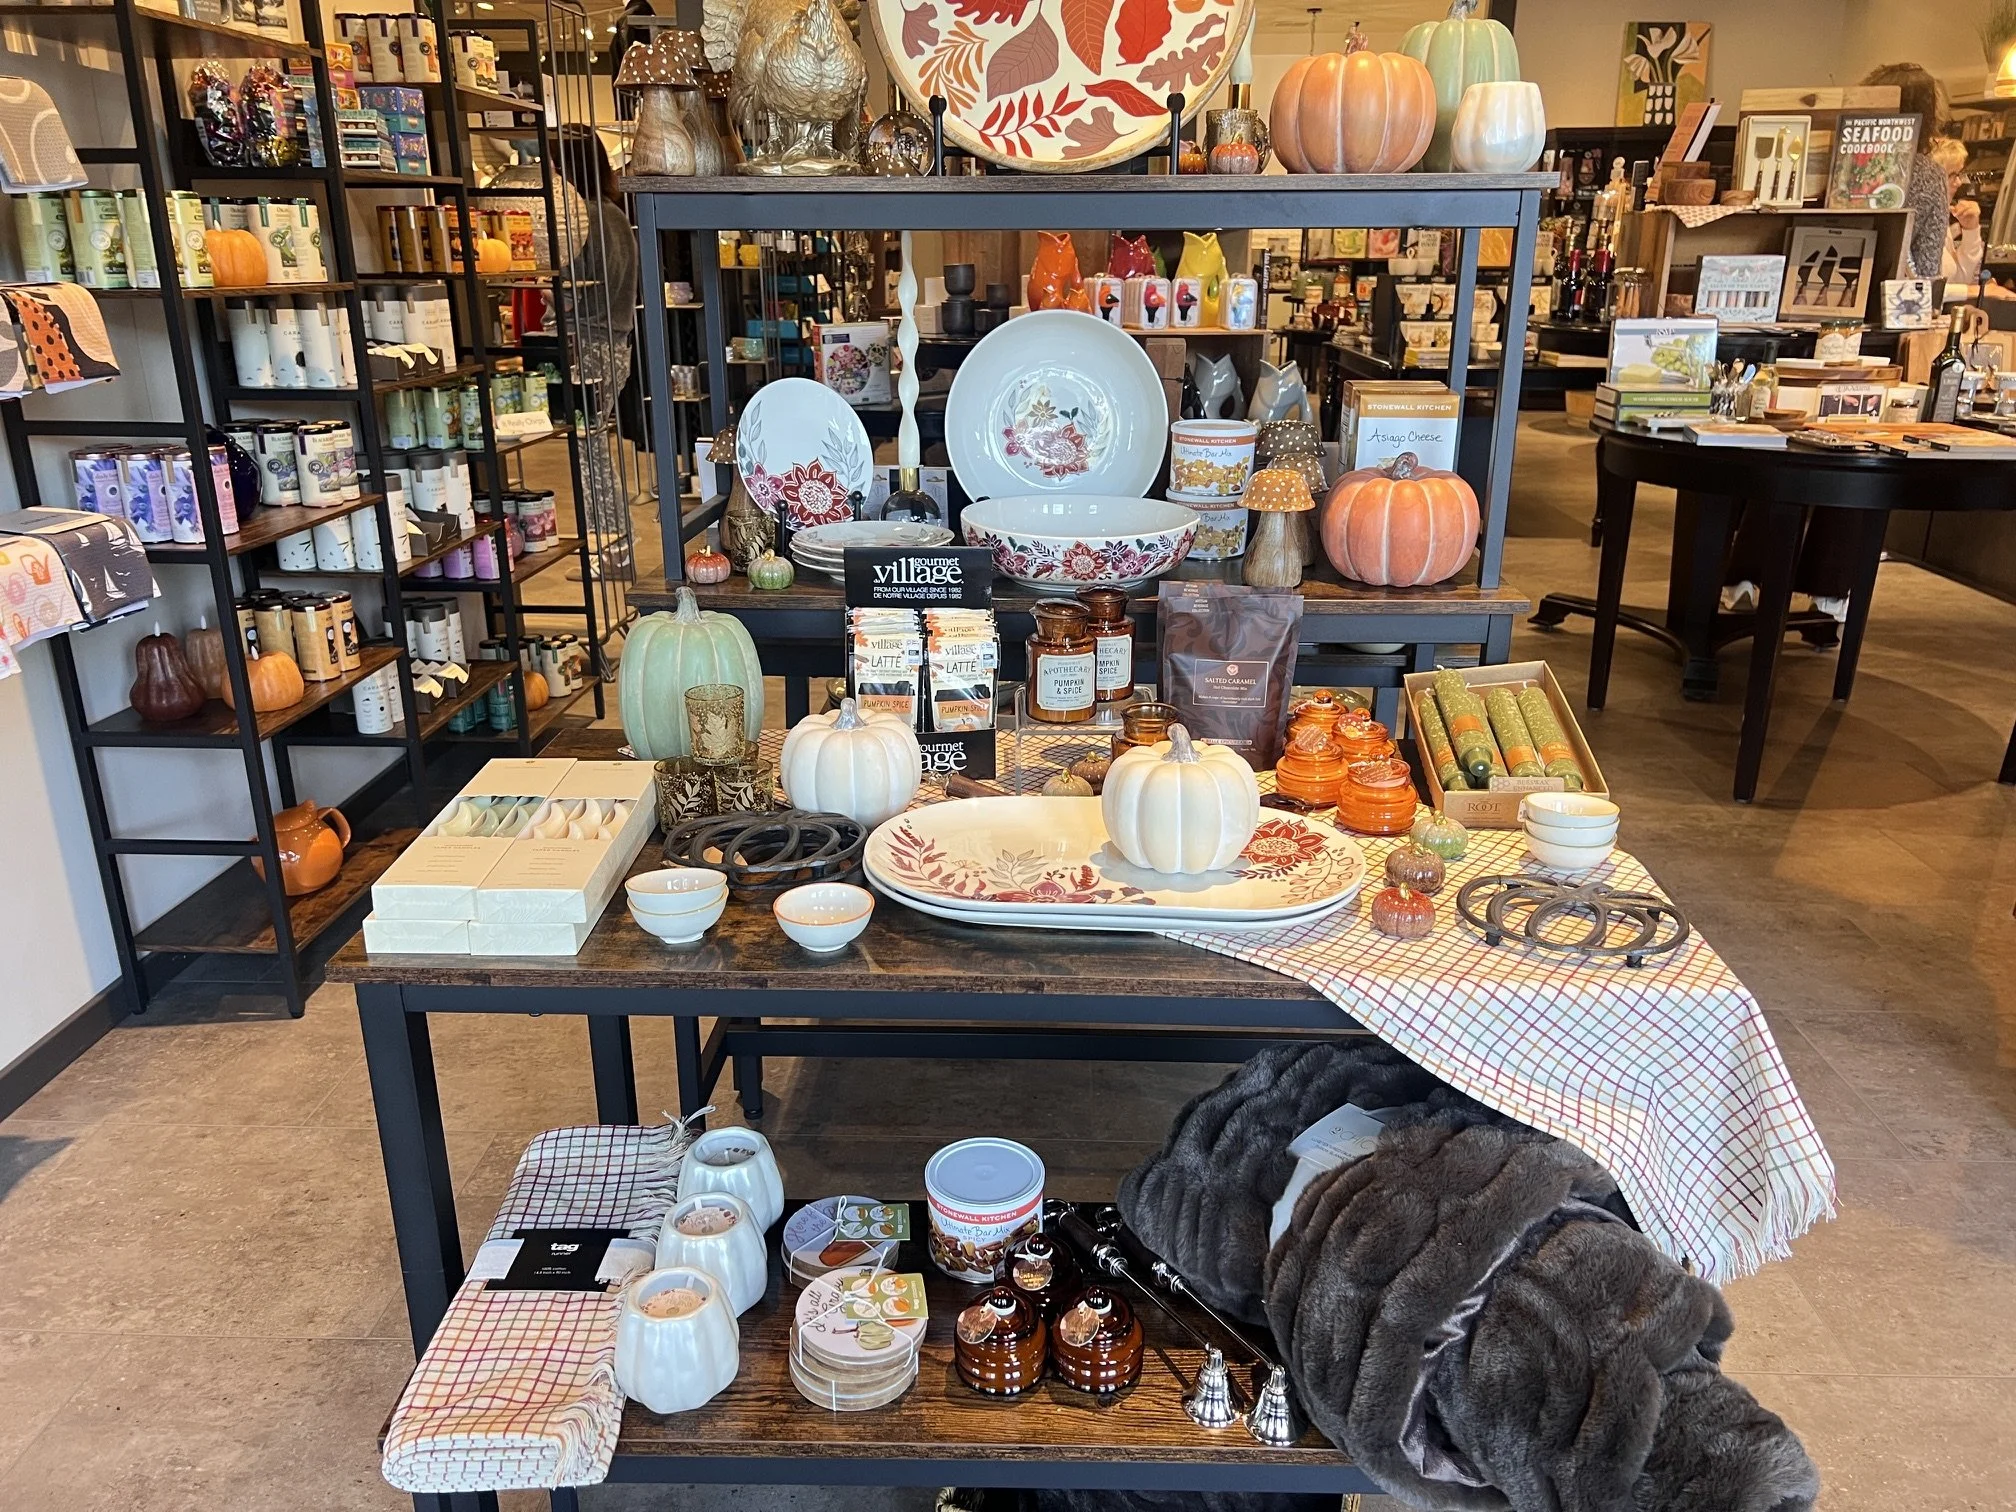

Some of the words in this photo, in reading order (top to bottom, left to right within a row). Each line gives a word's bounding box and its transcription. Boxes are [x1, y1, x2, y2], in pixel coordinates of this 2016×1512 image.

[1878, 118, 1915, 126] NORTHWEST
[1842, 126, 1914, 142] SEAFOOD
[1840, 143, 1896, 154] COOKBOOK
[1367, 403, 1415, 411] STONEWALL
[1179, 436, 1210, 444] STONEWALL
[1367, 428, 1406, 448] Asiago
[1407, 430, 1444, 443] Cheese
[1180, 446, 1203, 457] Ultimate
[1203, 447, 1218, 458] Bar
[1218, 448, 1232, 457] Mix
[1201, 512, 1217, 522] Bar
[1217, 513, 1230, 521] Mix
[914, 558, 960, 566] gourmet
[873, 557, 963, 584] village
[871, 638, 903, 650] village
[945, 645, 977, 656] village
[1043, 666, 1092, 676] APOTHECARY
[1064, 686, 1082, 694] SPICE
[864, 700, 890, 708] PUMPKIN
[892, 700, 909, 709] SPICE
[942, 706, 968, 714] PUMPKIN
[1467, 802, 1502, 812] ROOT
[936, 1202, 980, 1222] STONEWALL
[981, 1211, 1017, 1222] KITCHEN
[940, 1218, 972, 1236] Ultimate
[972, 1226, 992, 1238] Bar
[991, 1225, 1010, 1236] Mix
[550, 1242, 580, 1252] tag
[810, 1289, 822, 1308] all
